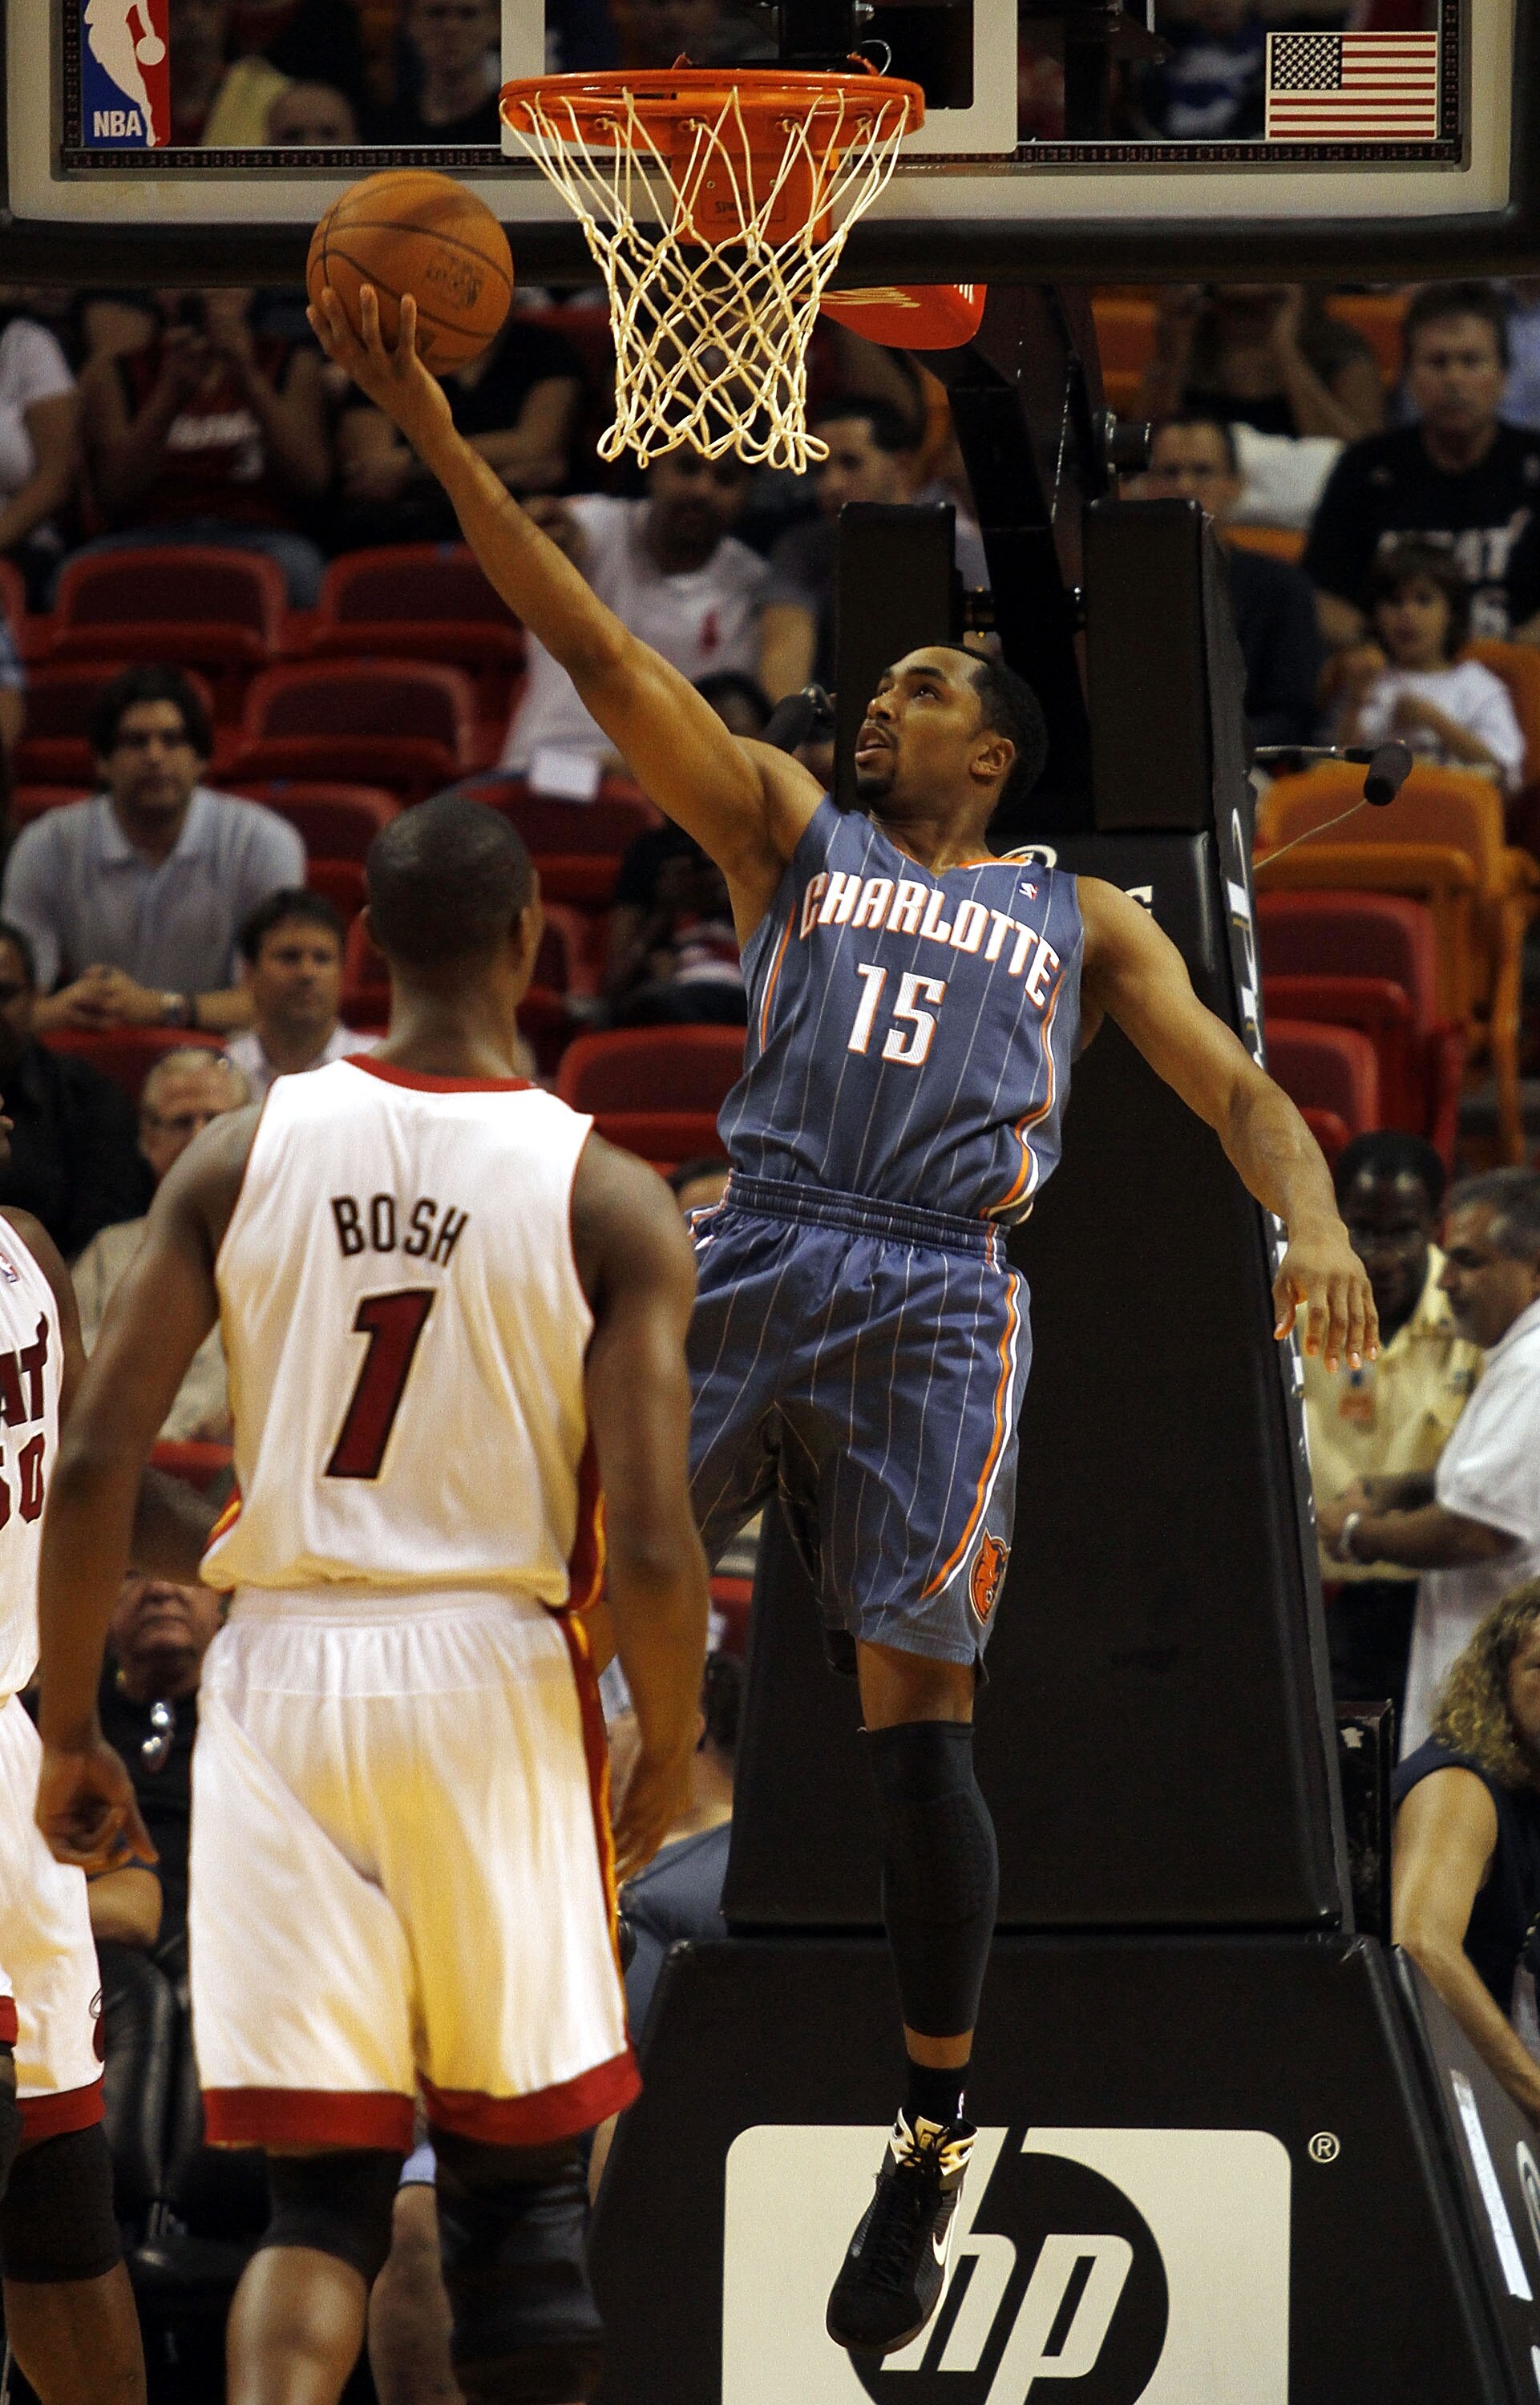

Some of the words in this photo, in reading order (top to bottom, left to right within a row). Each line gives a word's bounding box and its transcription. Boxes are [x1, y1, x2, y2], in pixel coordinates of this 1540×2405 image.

[93, 110, 143, 137] NBA
[799, 871, 1061, 1011] CHARLOTTE
[847, 962, 948, 1067] 15
[331, 1193, 469, 1267] BOSH
[324, 1287, 436, 1480] 1
